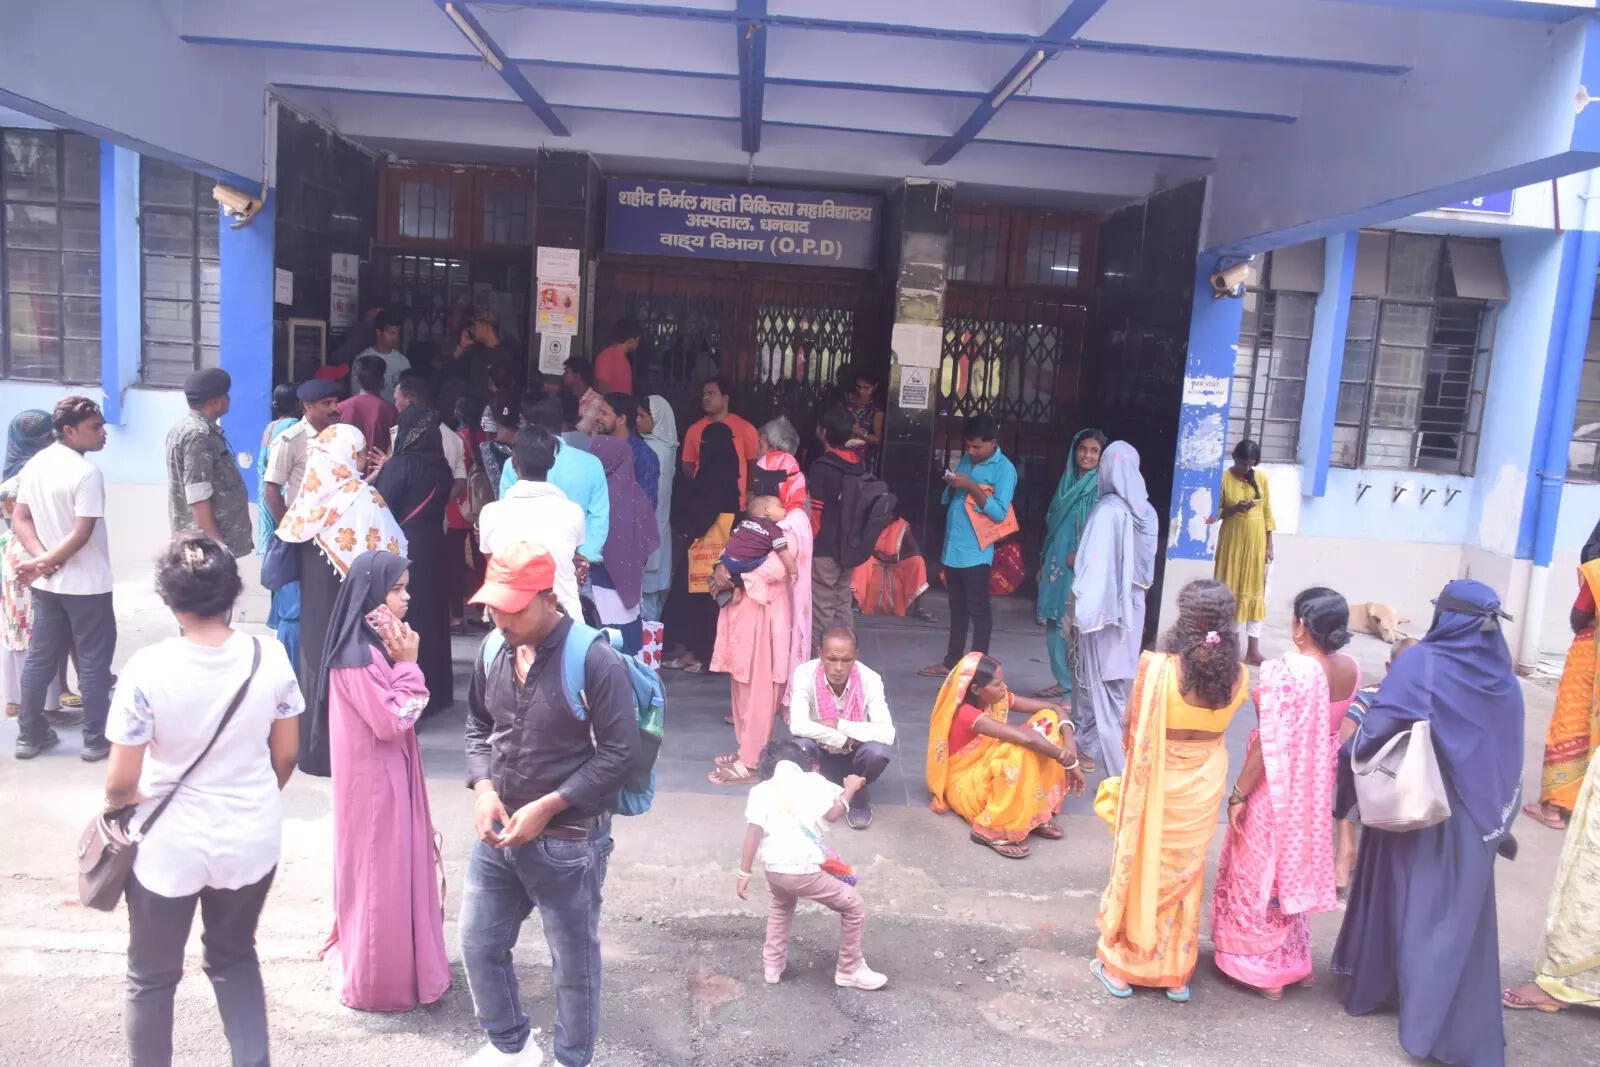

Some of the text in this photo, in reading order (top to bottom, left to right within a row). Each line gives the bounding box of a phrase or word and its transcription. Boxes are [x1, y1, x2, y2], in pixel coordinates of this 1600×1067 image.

[618, 186, 873, 222] शहीद निर्मल महतो चिकित्सा महाविद्यालय
[685, 213, 810, 234] अस्पताल, धनबाद
[710, 232, 765, 252] विभाग
[770, 236, 843, 261] (O.P.D)
